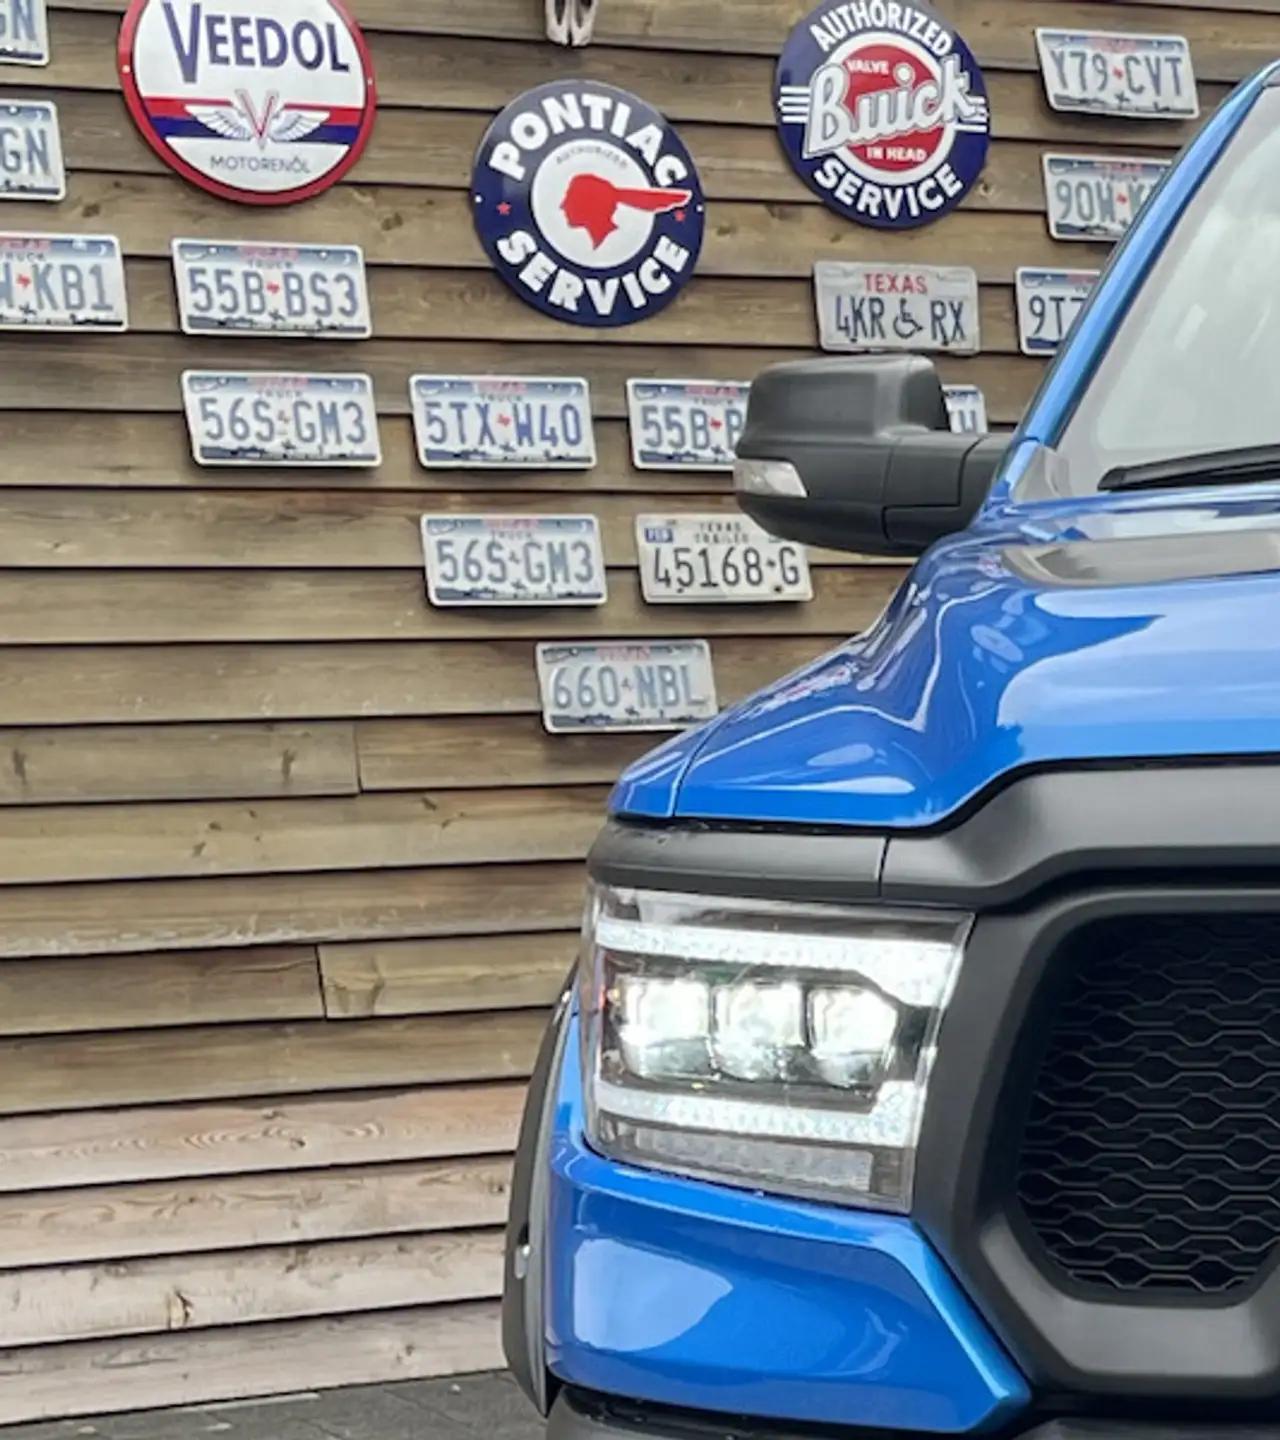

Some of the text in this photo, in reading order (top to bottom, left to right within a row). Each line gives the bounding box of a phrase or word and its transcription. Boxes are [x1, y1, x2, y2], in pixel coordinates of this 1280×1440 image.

[163, 2, 350, 83] VEEDOL
[810, 0, 952, 56] AUTHORIZED
[847, 60, 889, 74] VALVE
[802, 53, 978, 158] Buick
[489, 93, 688, 187] PONTIAC
[814, 158, 963, 218] SERVICE
[497, 230, 689, 316] SERVICE
[864, 273, 928, 294] TEXAS
[931, 300, 966, 342] RX
